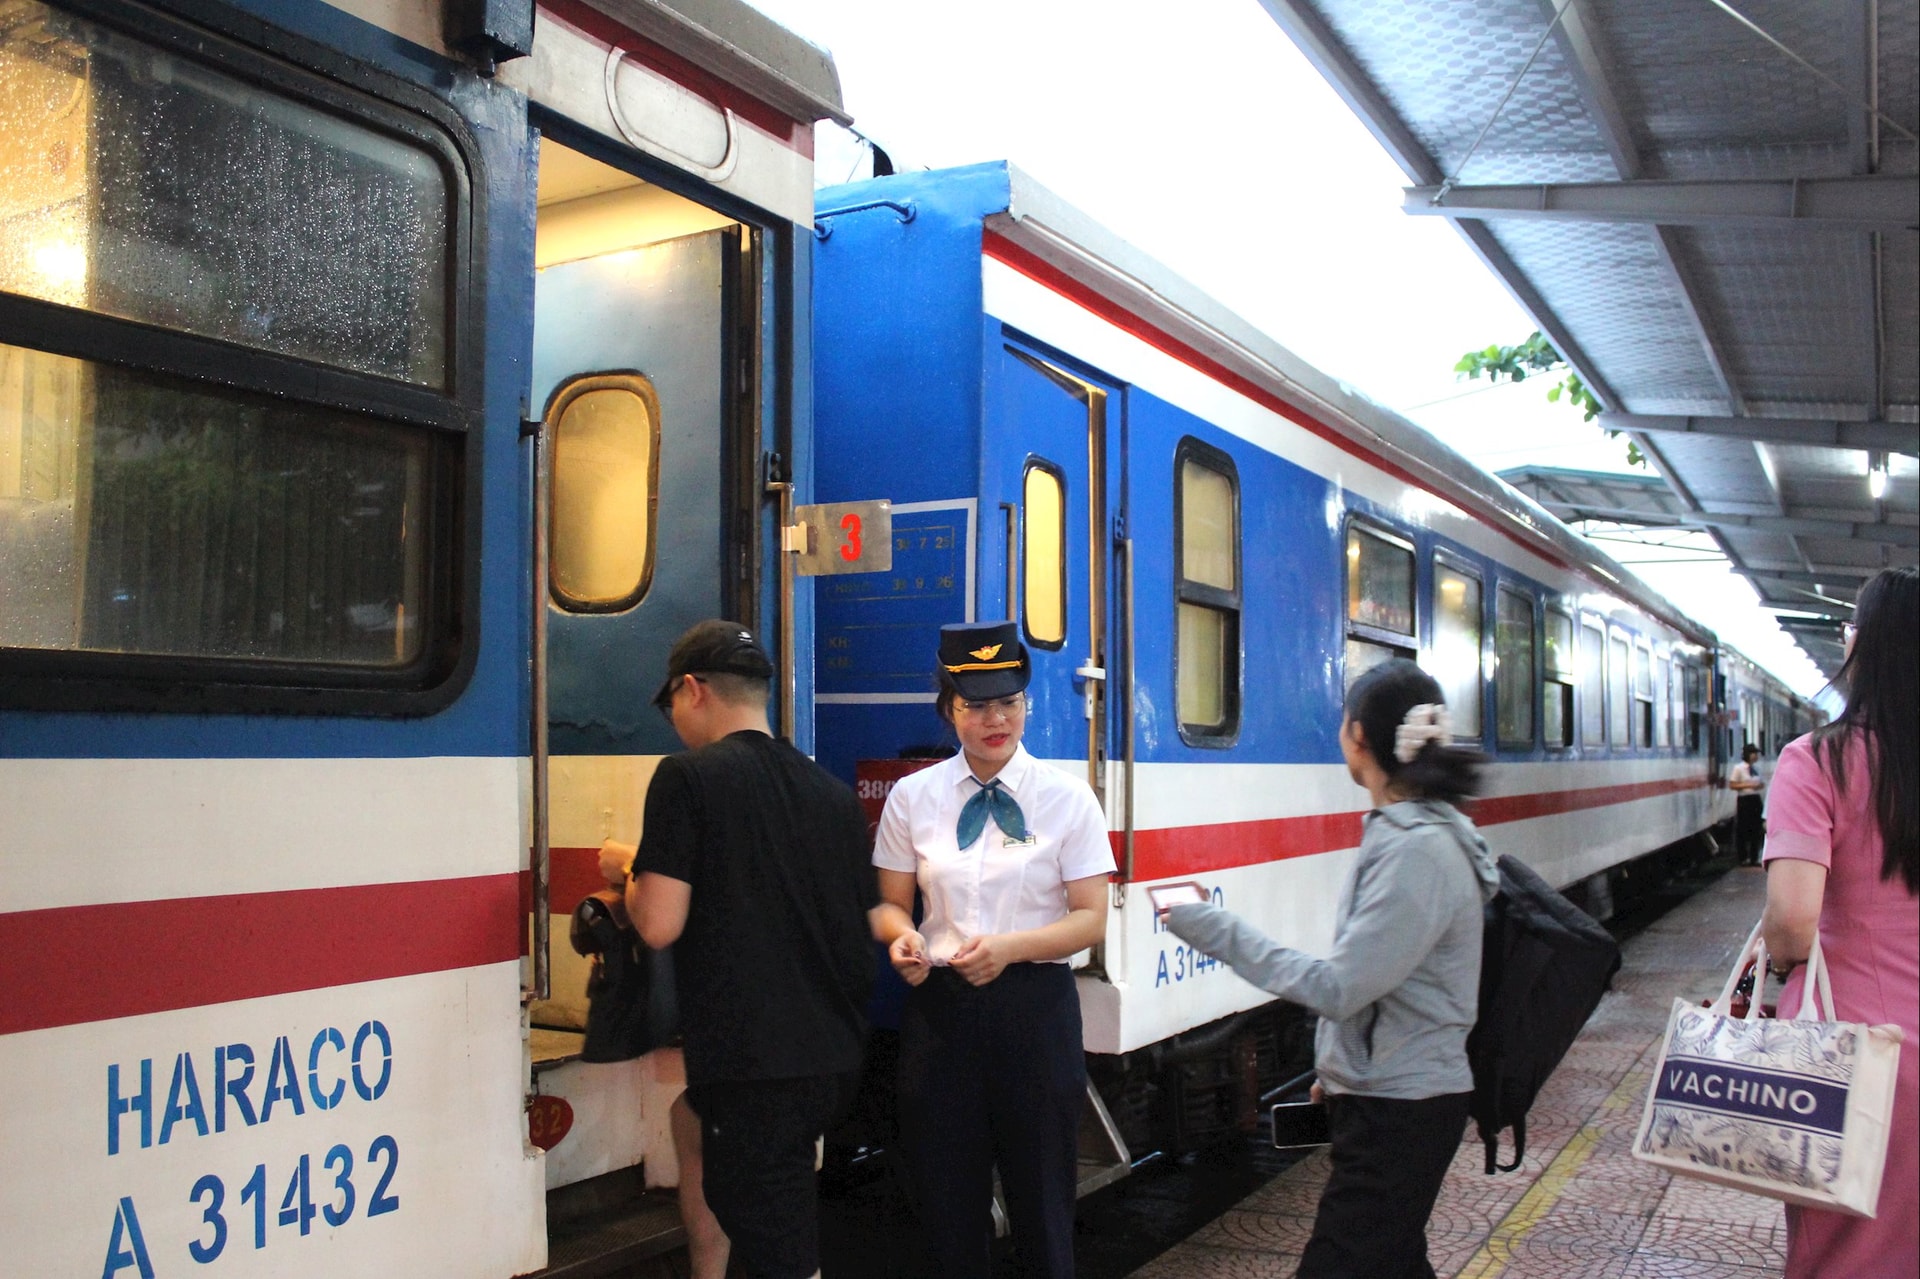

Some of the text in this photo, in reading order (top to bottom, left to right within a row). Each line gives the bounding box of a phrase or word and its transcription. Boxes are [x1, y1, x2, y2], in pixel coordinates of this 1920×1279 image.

[841, 514, 861, 561] 3
[1156, 945, 1225, 988] A 3144
[107, 1019, 392, 1156] HARACO
[1669, 1069, 1817, 1115] VACHINO
[101, 1134, 400, 1279] A 31432
